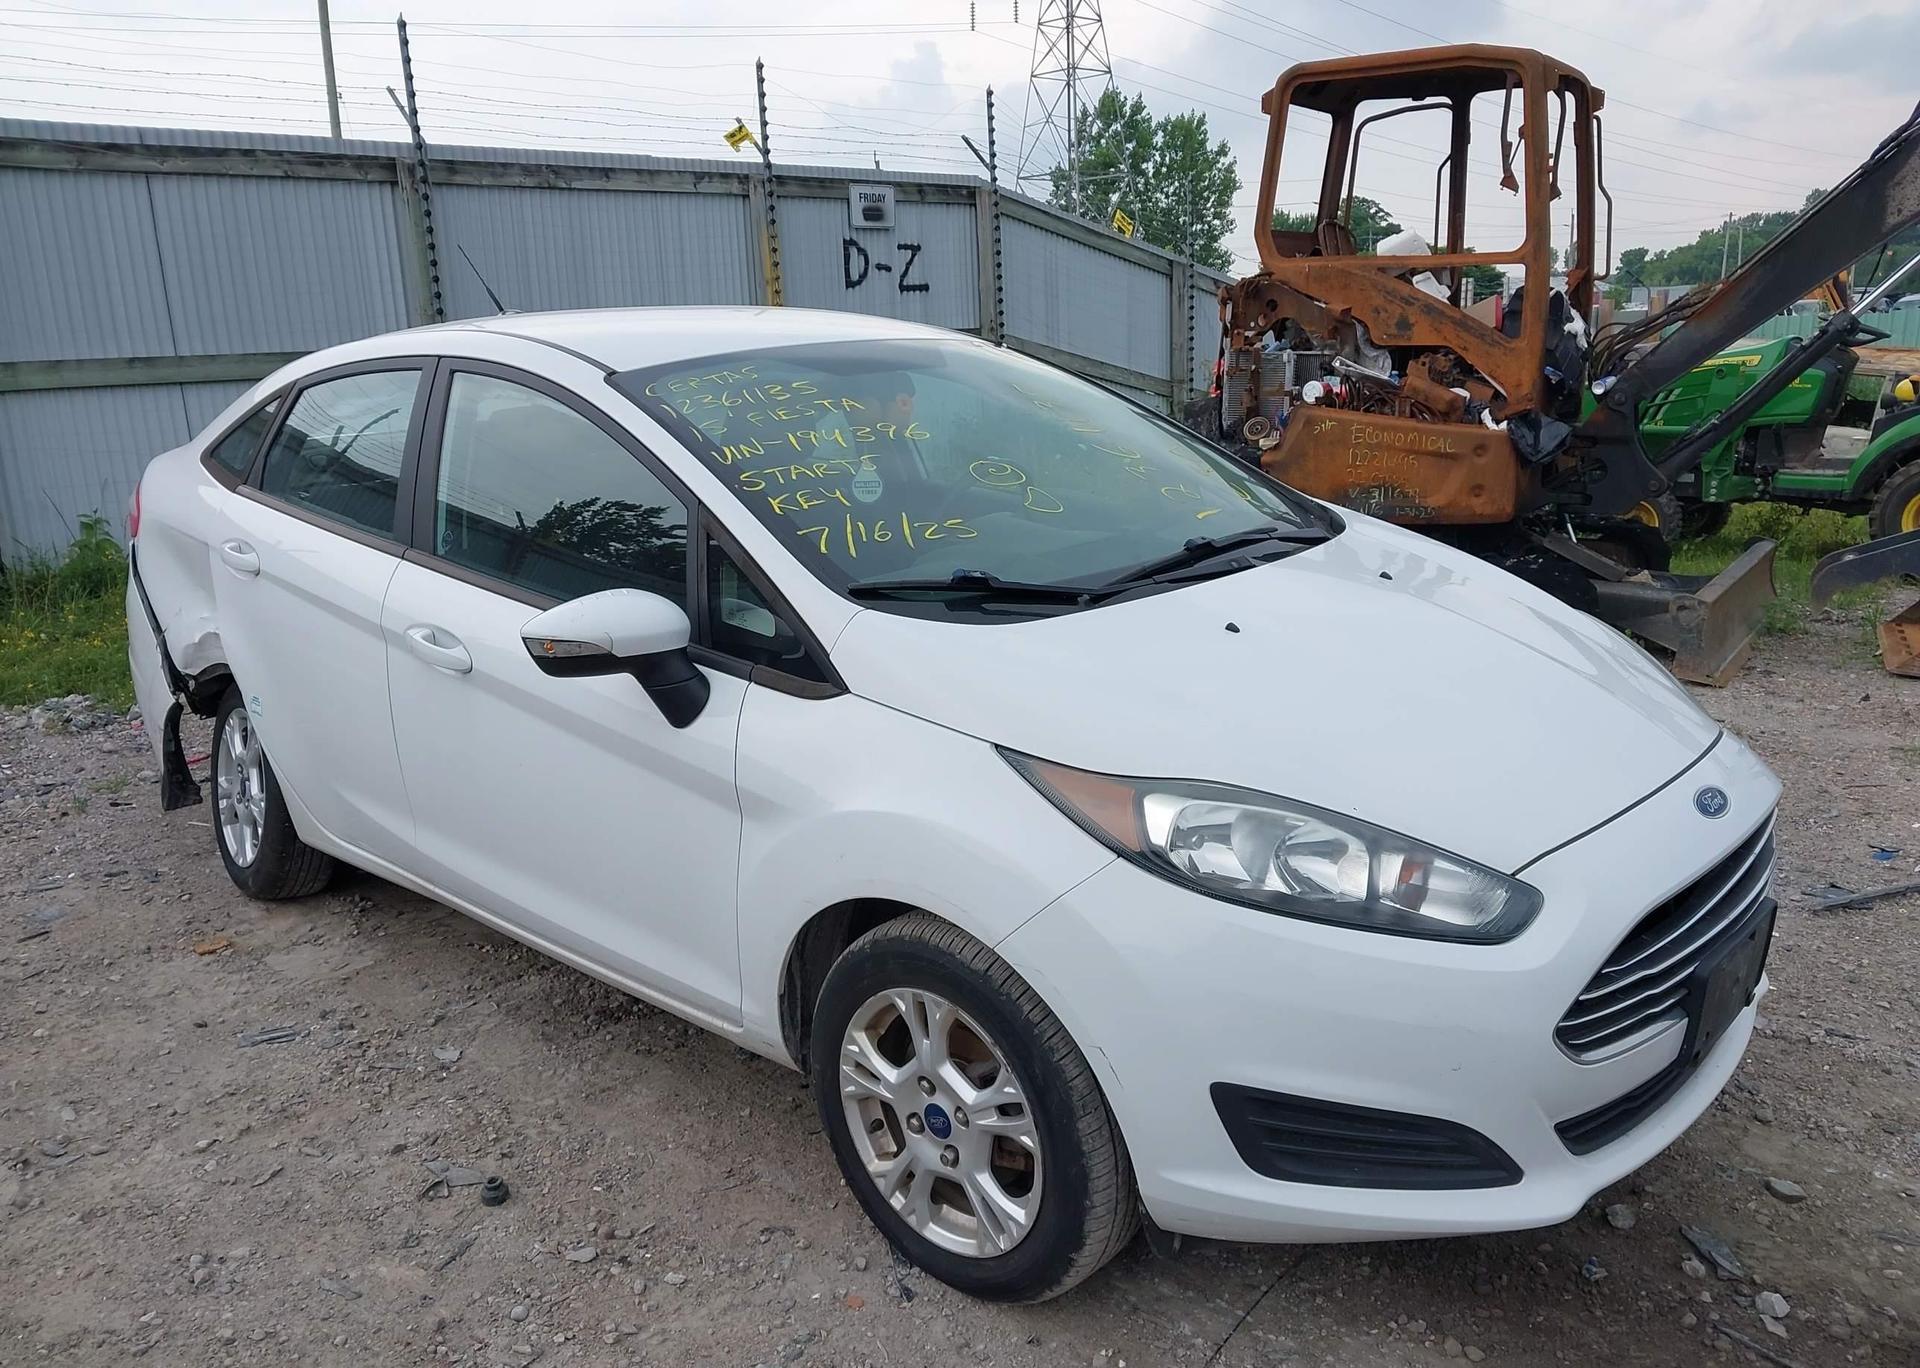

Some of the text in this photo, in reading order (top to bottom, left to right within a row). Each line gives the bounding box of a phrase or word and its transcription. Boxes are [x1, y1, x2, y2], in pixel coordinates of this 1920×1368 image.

[858, 192, 886, 203] FRIDAY
[646, 366, 757, 397] CERTAS
[660, 380, 818, 418] 12361135
[747, 397, 866, 427] FIESTA
[1350, 424, 1456, 452] ECONOMICAL
[740, 454, 881, 491] STARTS
[767, 487, 852, 515] KEY
[796, 511, 978, 558] 7/16/25
[1701, 791, 1724, 813] Ford
